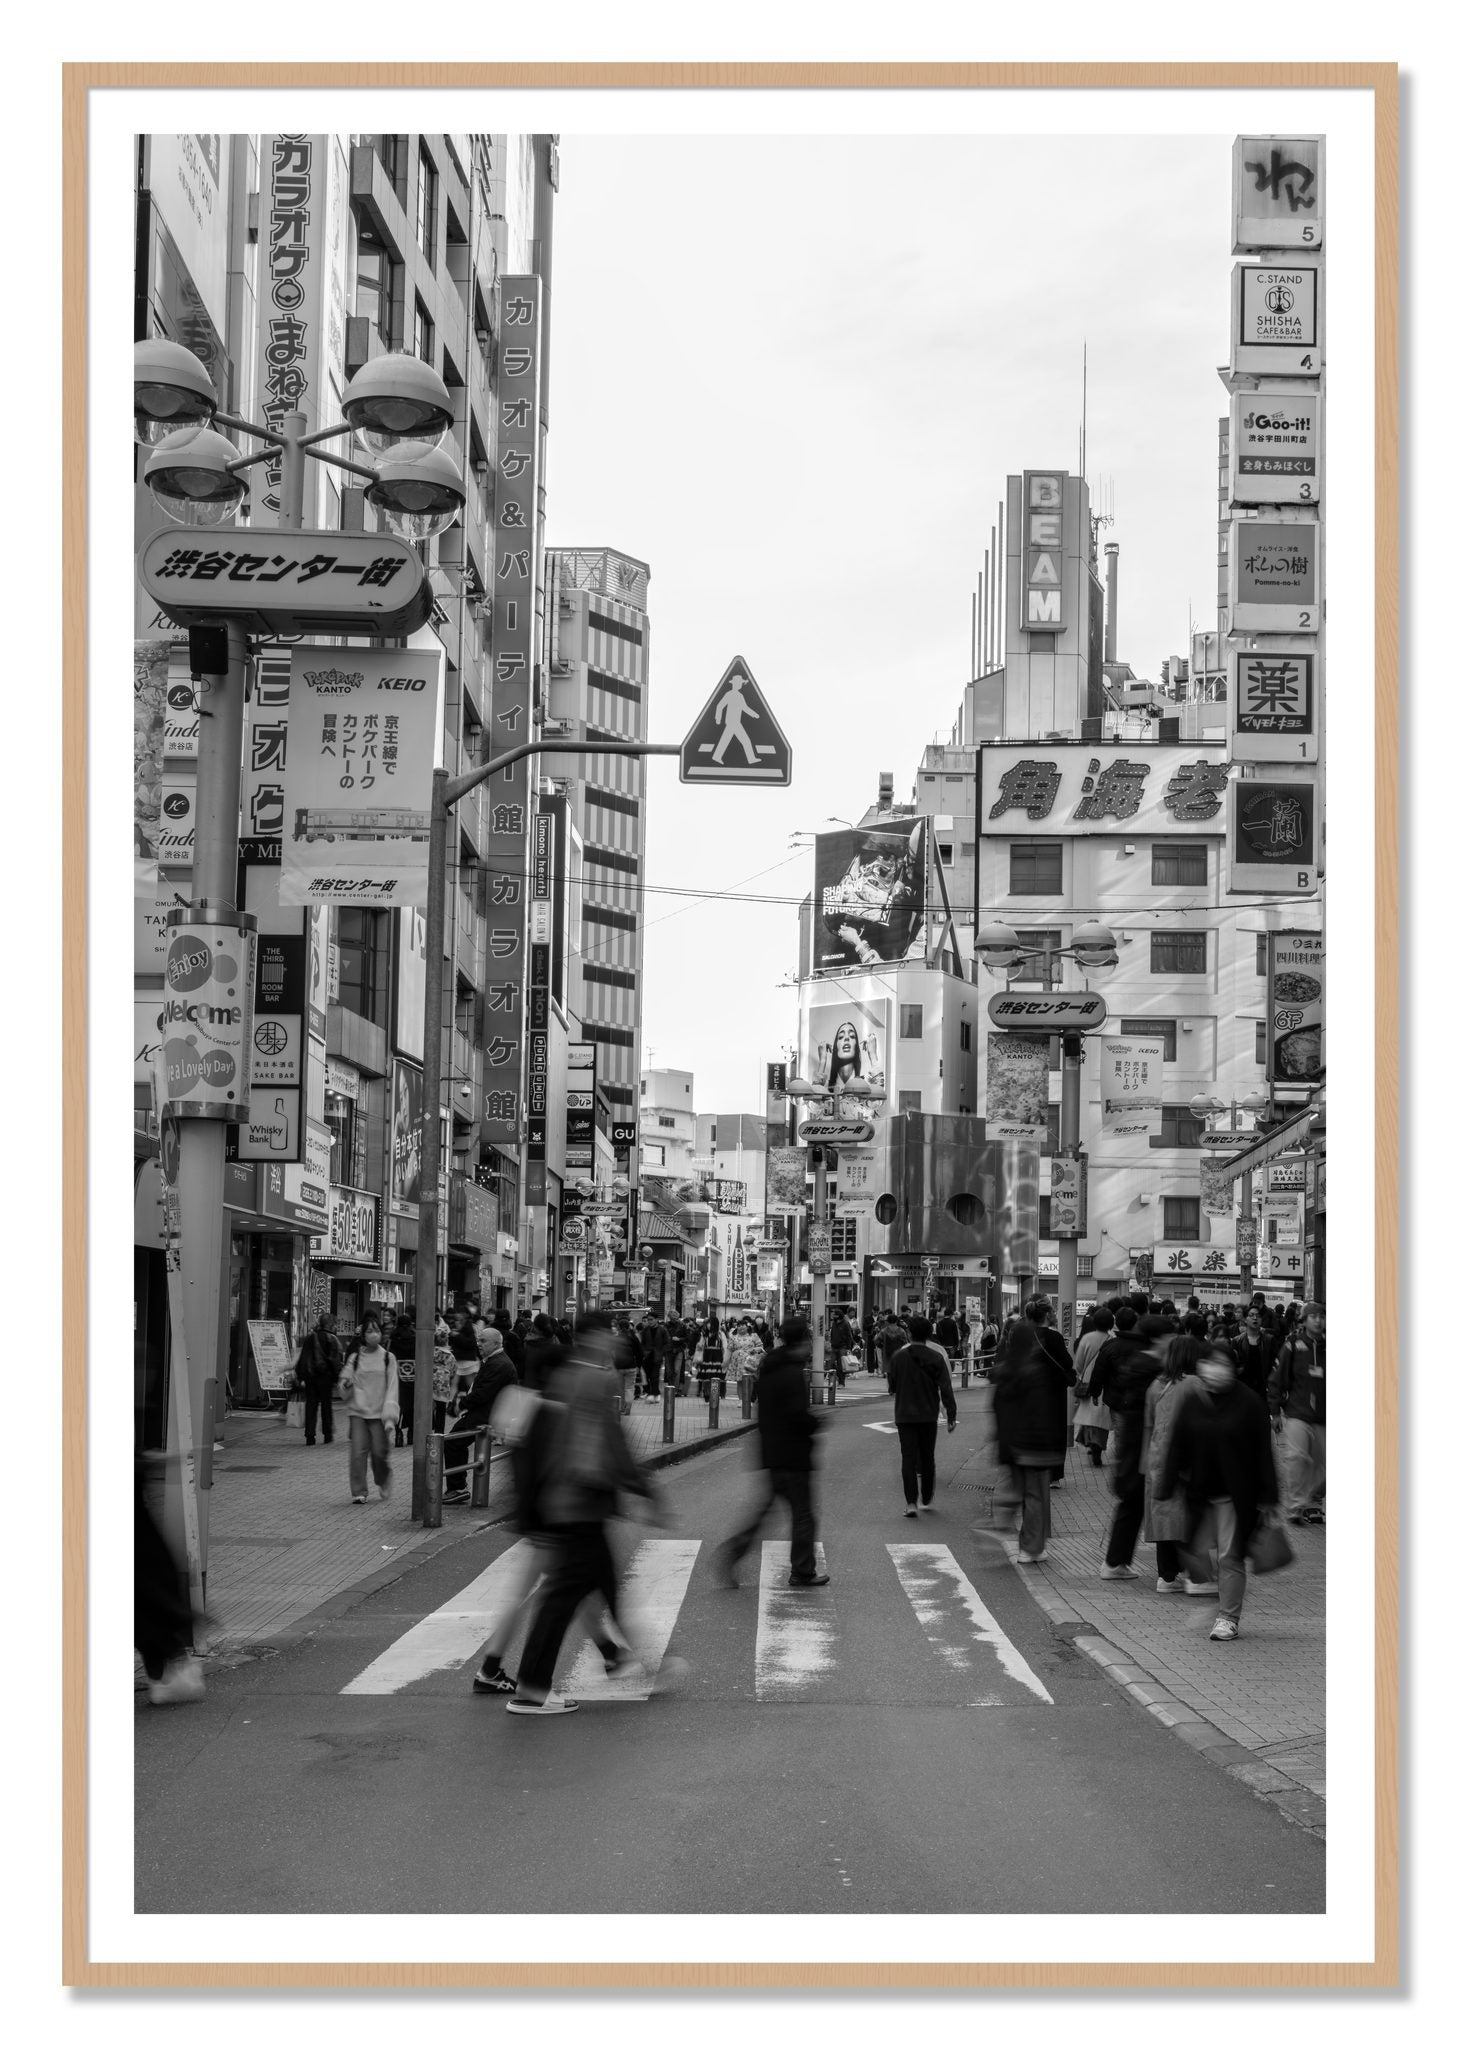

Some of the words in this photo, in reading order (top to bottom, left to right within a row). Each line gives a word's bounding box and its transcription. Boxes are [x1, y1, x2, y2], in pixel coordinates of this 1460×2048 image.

[270, 140, 312, 280] カラオケ
[1302, 226, 1314, 242] 5
[1256, 274, 1303, 284] C.STAND
[1256, 316, 1302, 326] SHISHA
[1300, 354, 1313, 370] 4
[1248, 434, 1307, 444] 渋谷宇田川町店
[1243, 460, 1312, 472] 全身もみほぐし
[1300, 483, 1312, 499] 3
[1030, 477, 1062, 623] BEAM
[155, 548, 408, 588] 渋谷センター街
[1244, 555, 1309, 575] ポムの樹
[1254, 578, 1301, 586] Pomme-no-ki
[1299, 612, 1311, 627] 2
[316, 686, 352, 694] KANTO
[377, 677, 427, 692] KEIO
[1247, 661, 1299, 713] 薬
[1242, 716, 1304, 730] マツモトキヨシ
[320, 713, 338, 758] 冒険へ
[168, 742, 194, 751] 渋谷店
[339, 713, 358, 789] カントーの
[360, 713, 379, 790] ポケパーク
[381, 714, 400, 775] 京王線で
[1298, 742, 1307, 757] 1
[989, 759, 1232, 820] 角海老
[538, 819, 548, 855] kimono
[164, 850, 190, 859] 渋谷店
[308, 878, 398, 892] 渋谷センター街
[537, 861, 547, 895] hearts
[1297, 872, 1309, 887] B
[167, 949, 209, 984] Enjoy
[486, 875, 521, 1121] カラオケ館
[163, 999, 242, 1026] Welcome
[995, 1001, 1100, 1015] 渋谷センター街
[1274, 1011, 1303, 1031] 6F
[182, 1058, 212, 1078] Lovely
[214, 1059, 234, 1074] Day!
[249, 1124, 283, 1136] Whisky
[614, 1128, 635, 1140] GU
[801, 1125, 865, 1135] 渋谷センター街
[248, 1135, 269, 1143] Bank
[735, 1248, 744, 1291] BEER
